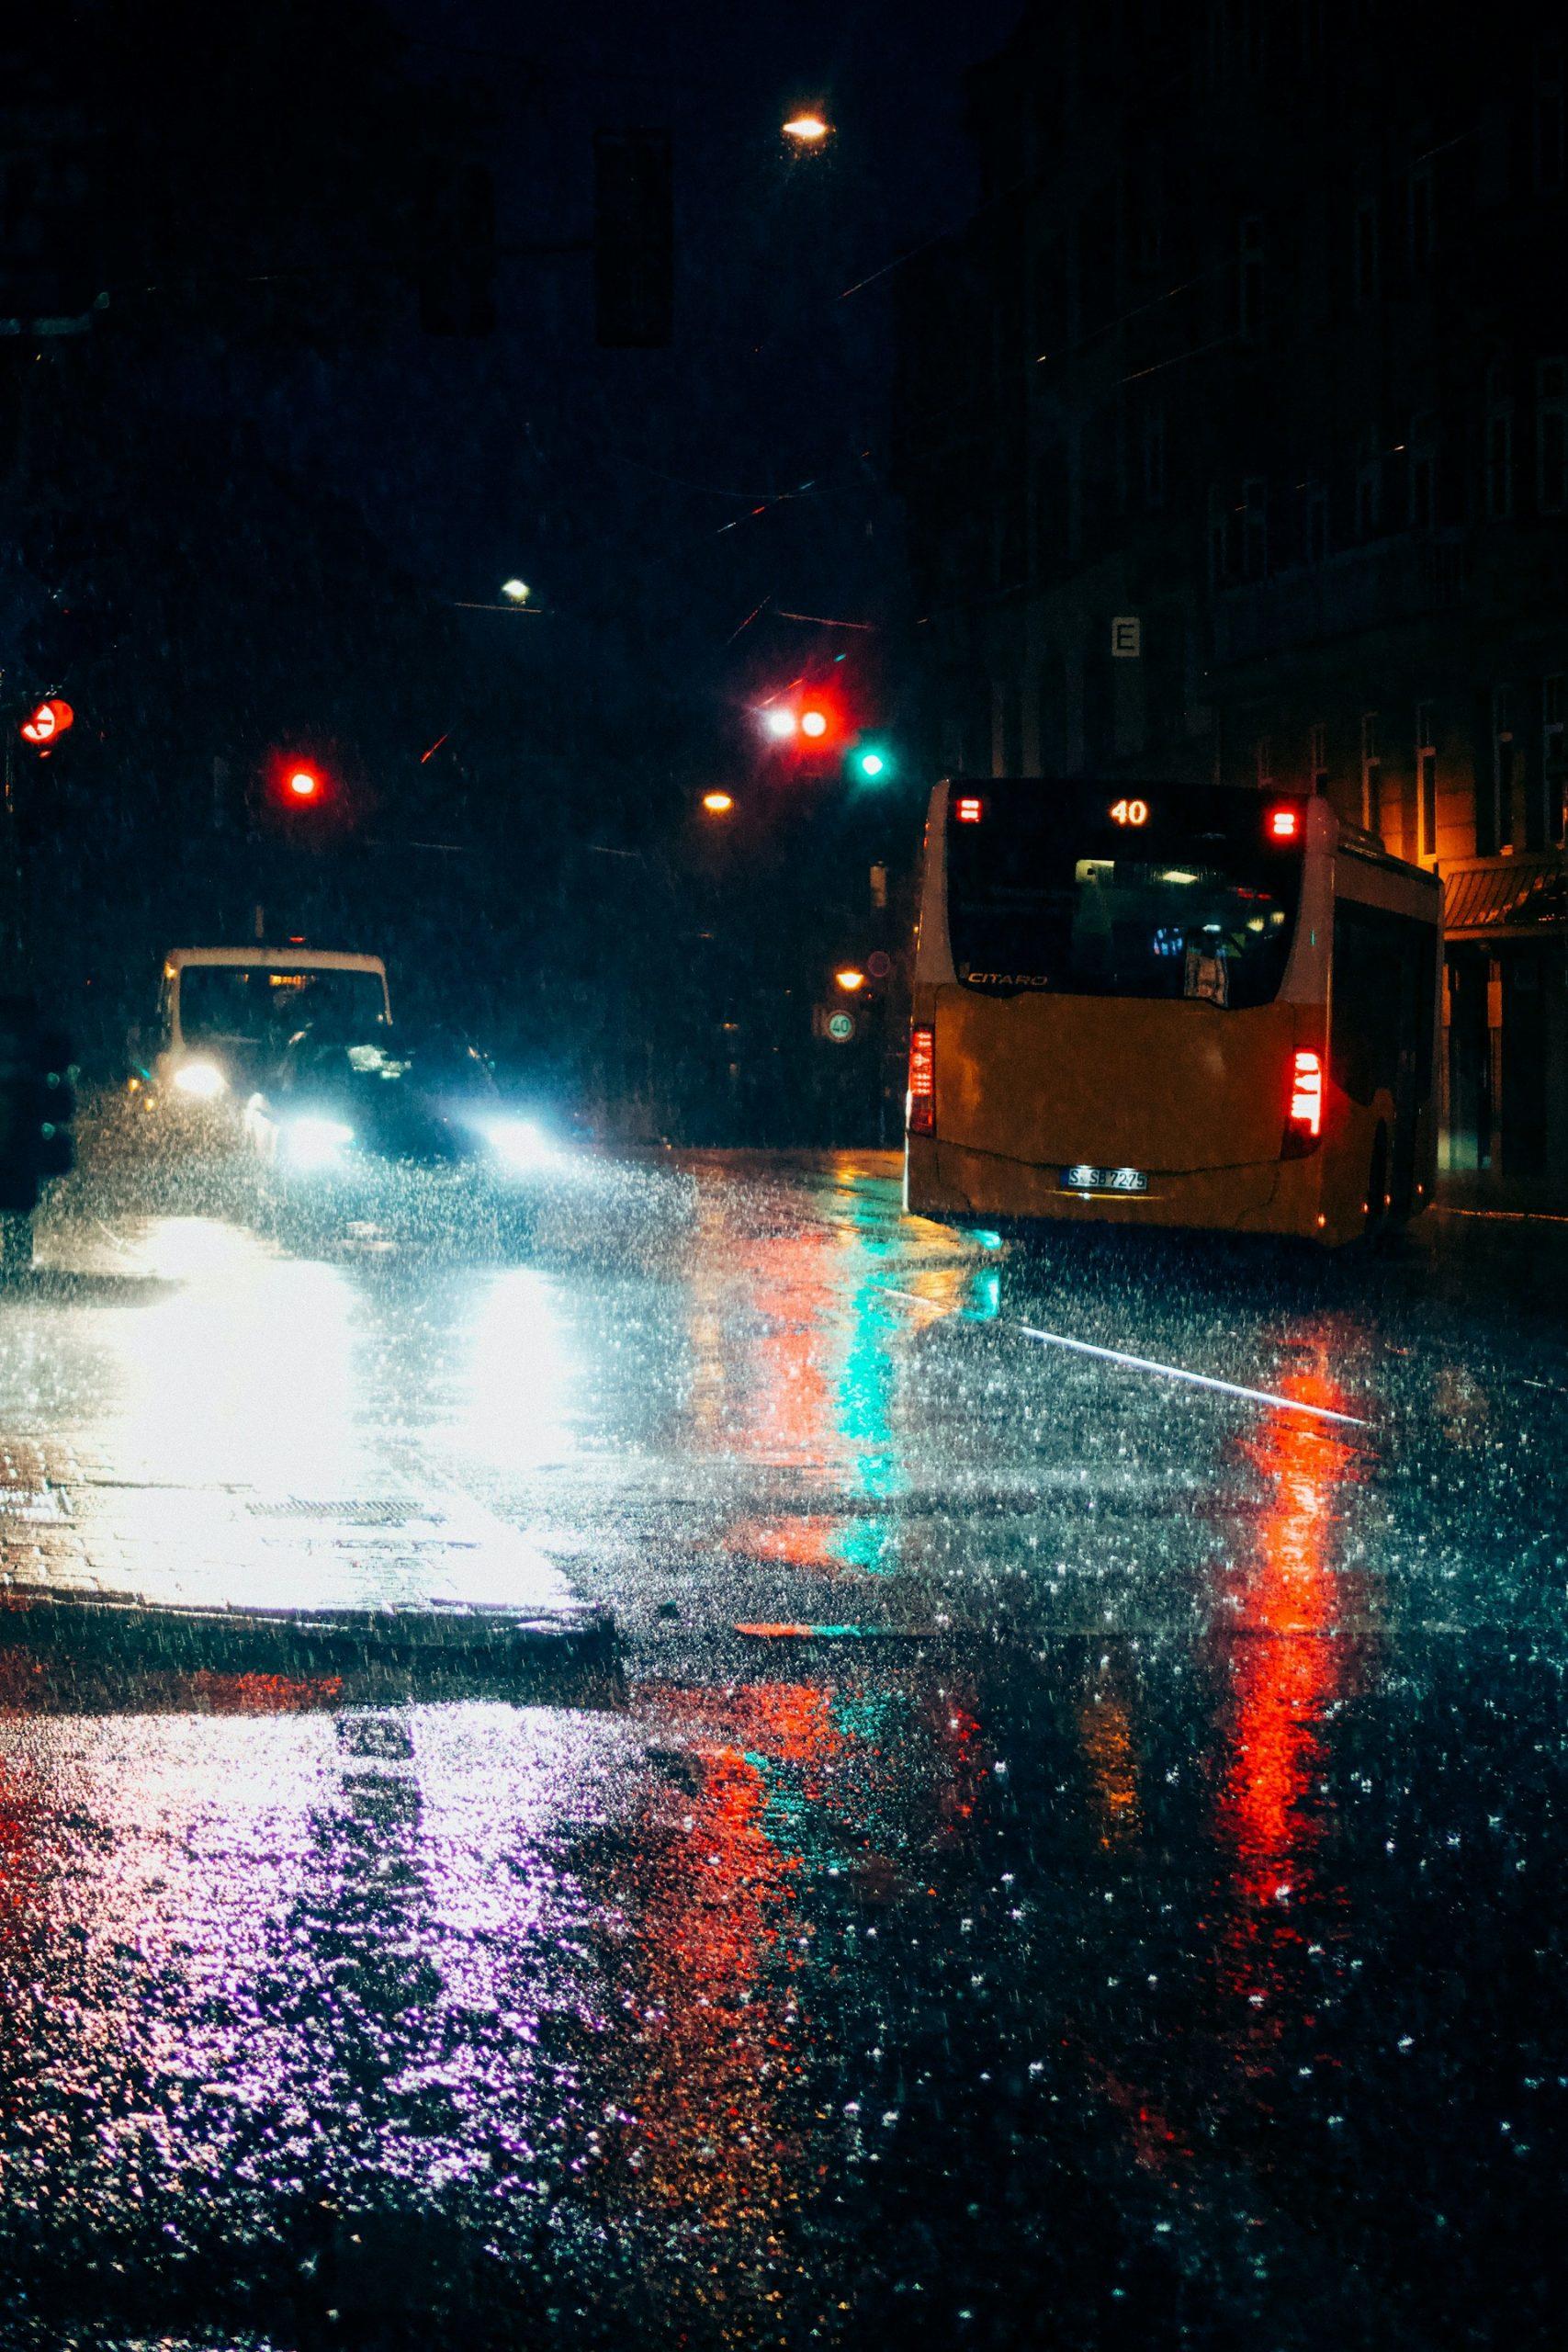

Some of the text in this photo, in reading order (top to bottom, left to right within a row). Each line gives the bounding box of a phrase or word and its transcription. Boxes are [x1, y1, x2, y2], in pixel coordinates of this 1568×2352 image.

[1117, 624, 1134, 650] E
[1111, 799, 1148, 825] 40
[967, 972, 1049, 986] CITARO
[832, 1019, 849, 1033] 40
